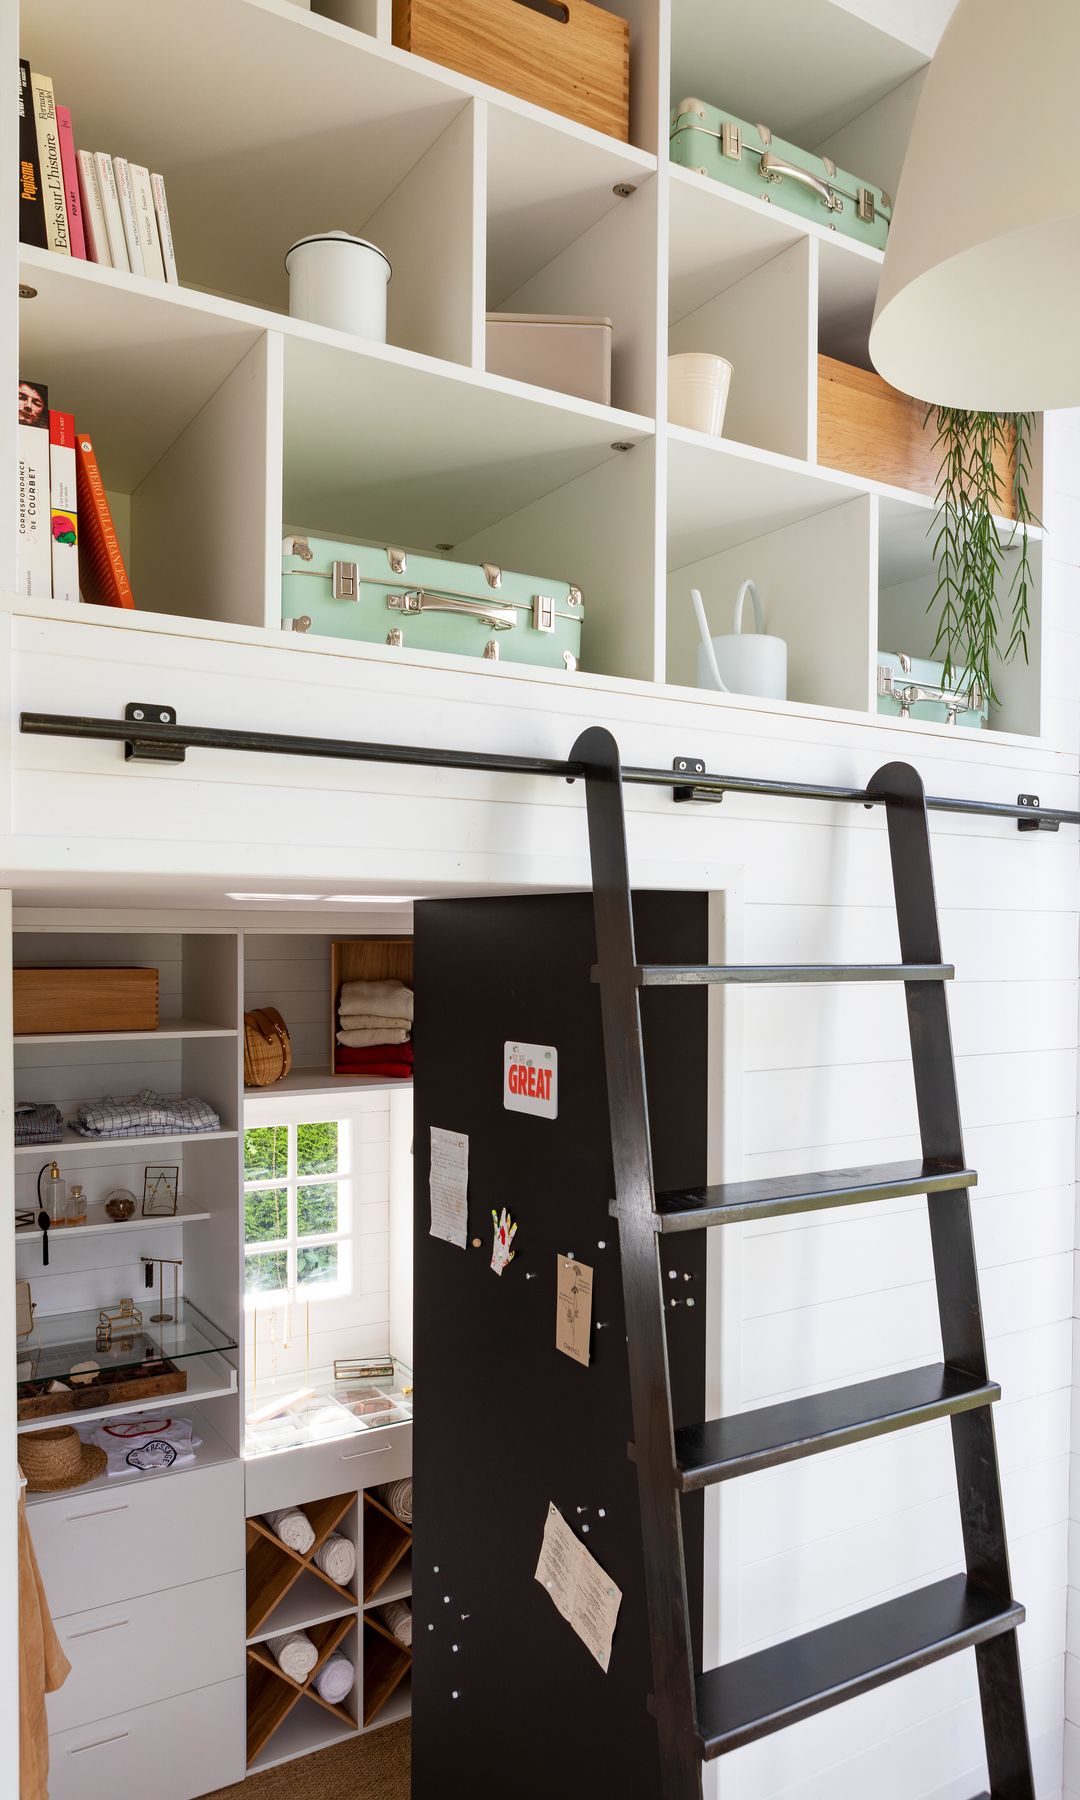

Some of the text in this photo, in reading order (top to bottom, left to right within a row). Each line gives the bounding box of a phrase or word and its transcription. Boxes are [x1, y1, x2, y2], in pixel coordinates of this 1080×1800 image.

[36, 88, 47, 120] Fernand
[44, 90, 55, 119] Braudel
[21, 161, 36, 201] Popisme
[45, 133, 67, 249] Ecrits sur L'histoire
[28, 467, 36, 515] COURBET
[88, 464, 129, 596] PIERO DELLA FRANCESCA
[508, 1063, 552, 1101] GREAT
